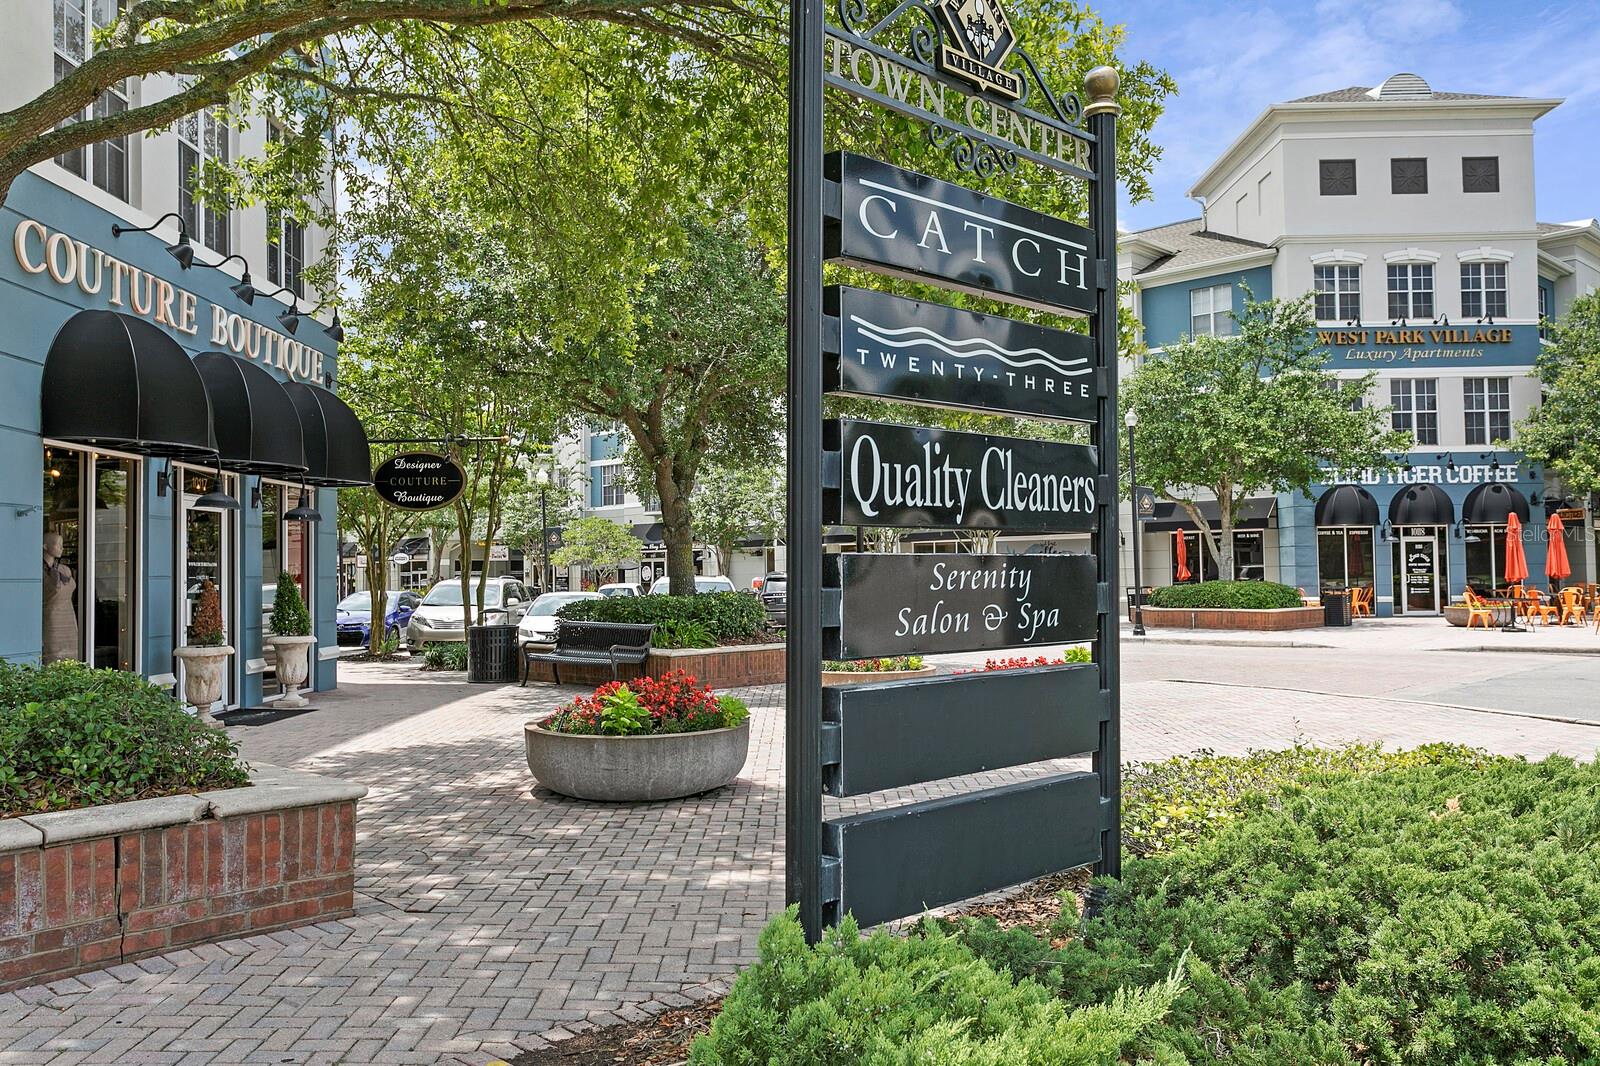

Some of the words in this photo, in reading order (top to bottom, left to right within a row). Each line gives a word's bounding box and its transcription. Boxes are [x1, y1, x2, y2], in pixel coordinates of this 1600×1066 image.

[951, 54, 1013, 89] VILLAGE
[825, 35, 948, 118] TOWN
[965, 95, 1093, 173] CENTER
[858, 194, 1089, 290] CATCH
[14, 219, 199, 336] COUTURE
[210, 304, 325, 385] BOUTIQUE
[1316, 329, 1370, 345] WEST
[1374, 329, 1426, 344] PARK
[1429, 328, 1513, 343] VILLAGE
[1344, 348, 1397, 362] Luxury
[1398, 347, 1483, 362] Apartments
[856, 348, 1090, 399] TWENTY-THREE
[389, 475, 448, 486] COUTURE
[394, 457, 442, 472] Designer
[850, 434, 971, 525] Quality
[981, 446, 1095, 514] Cleaners
[1384, 465, 1443, 484] TIGER
[1445, 465, 1519, 484] COFFEE
[394, 491, 445, 504] Boutique
[930, 561, 1032, 602] Serenity
[895, 600, 970, 637] Salon
[982, 603, 1009, 632] &
[1017, 601, 1060, 643] Spa
